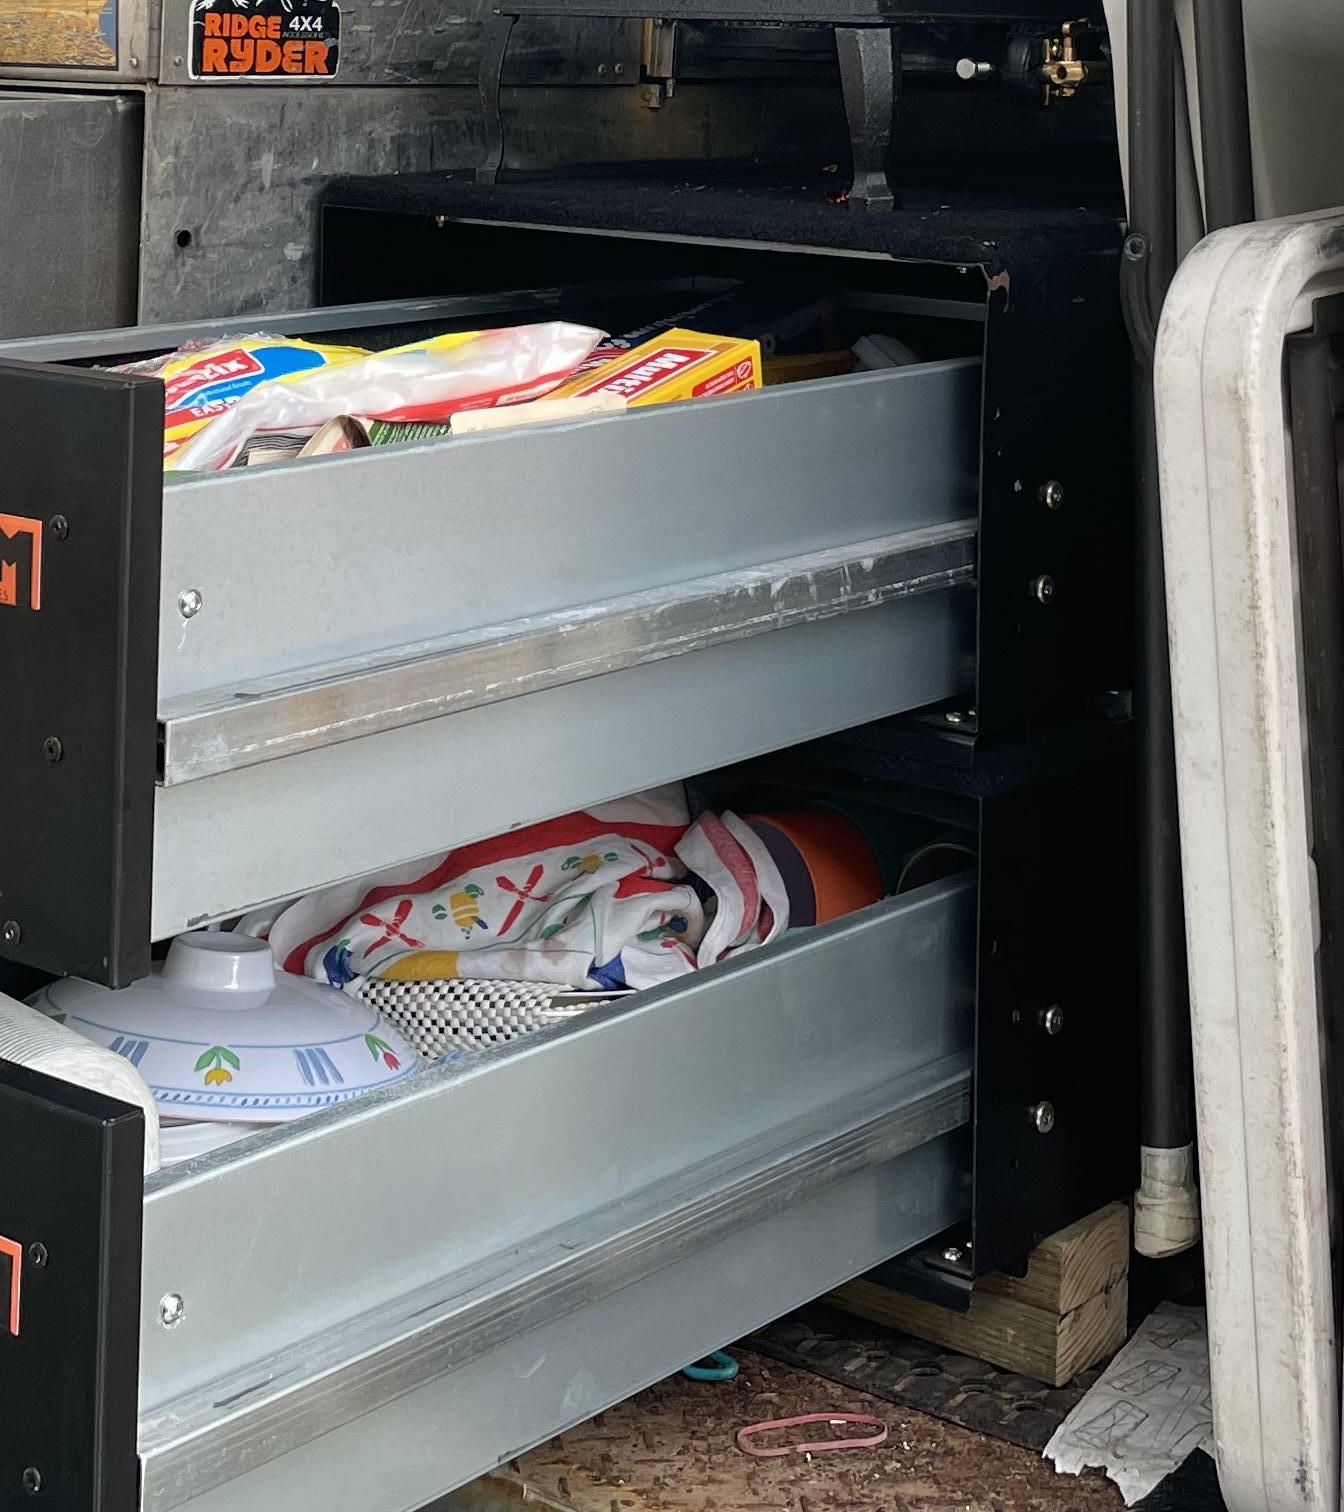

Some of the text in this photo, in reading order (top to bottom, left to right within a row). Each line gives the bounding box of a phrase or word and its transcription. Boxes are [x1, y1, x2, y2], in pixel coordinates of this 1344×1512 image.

[204, 13, 323, 38] RIDGE 4X4
[202, 38, 329, 74] RYDER
